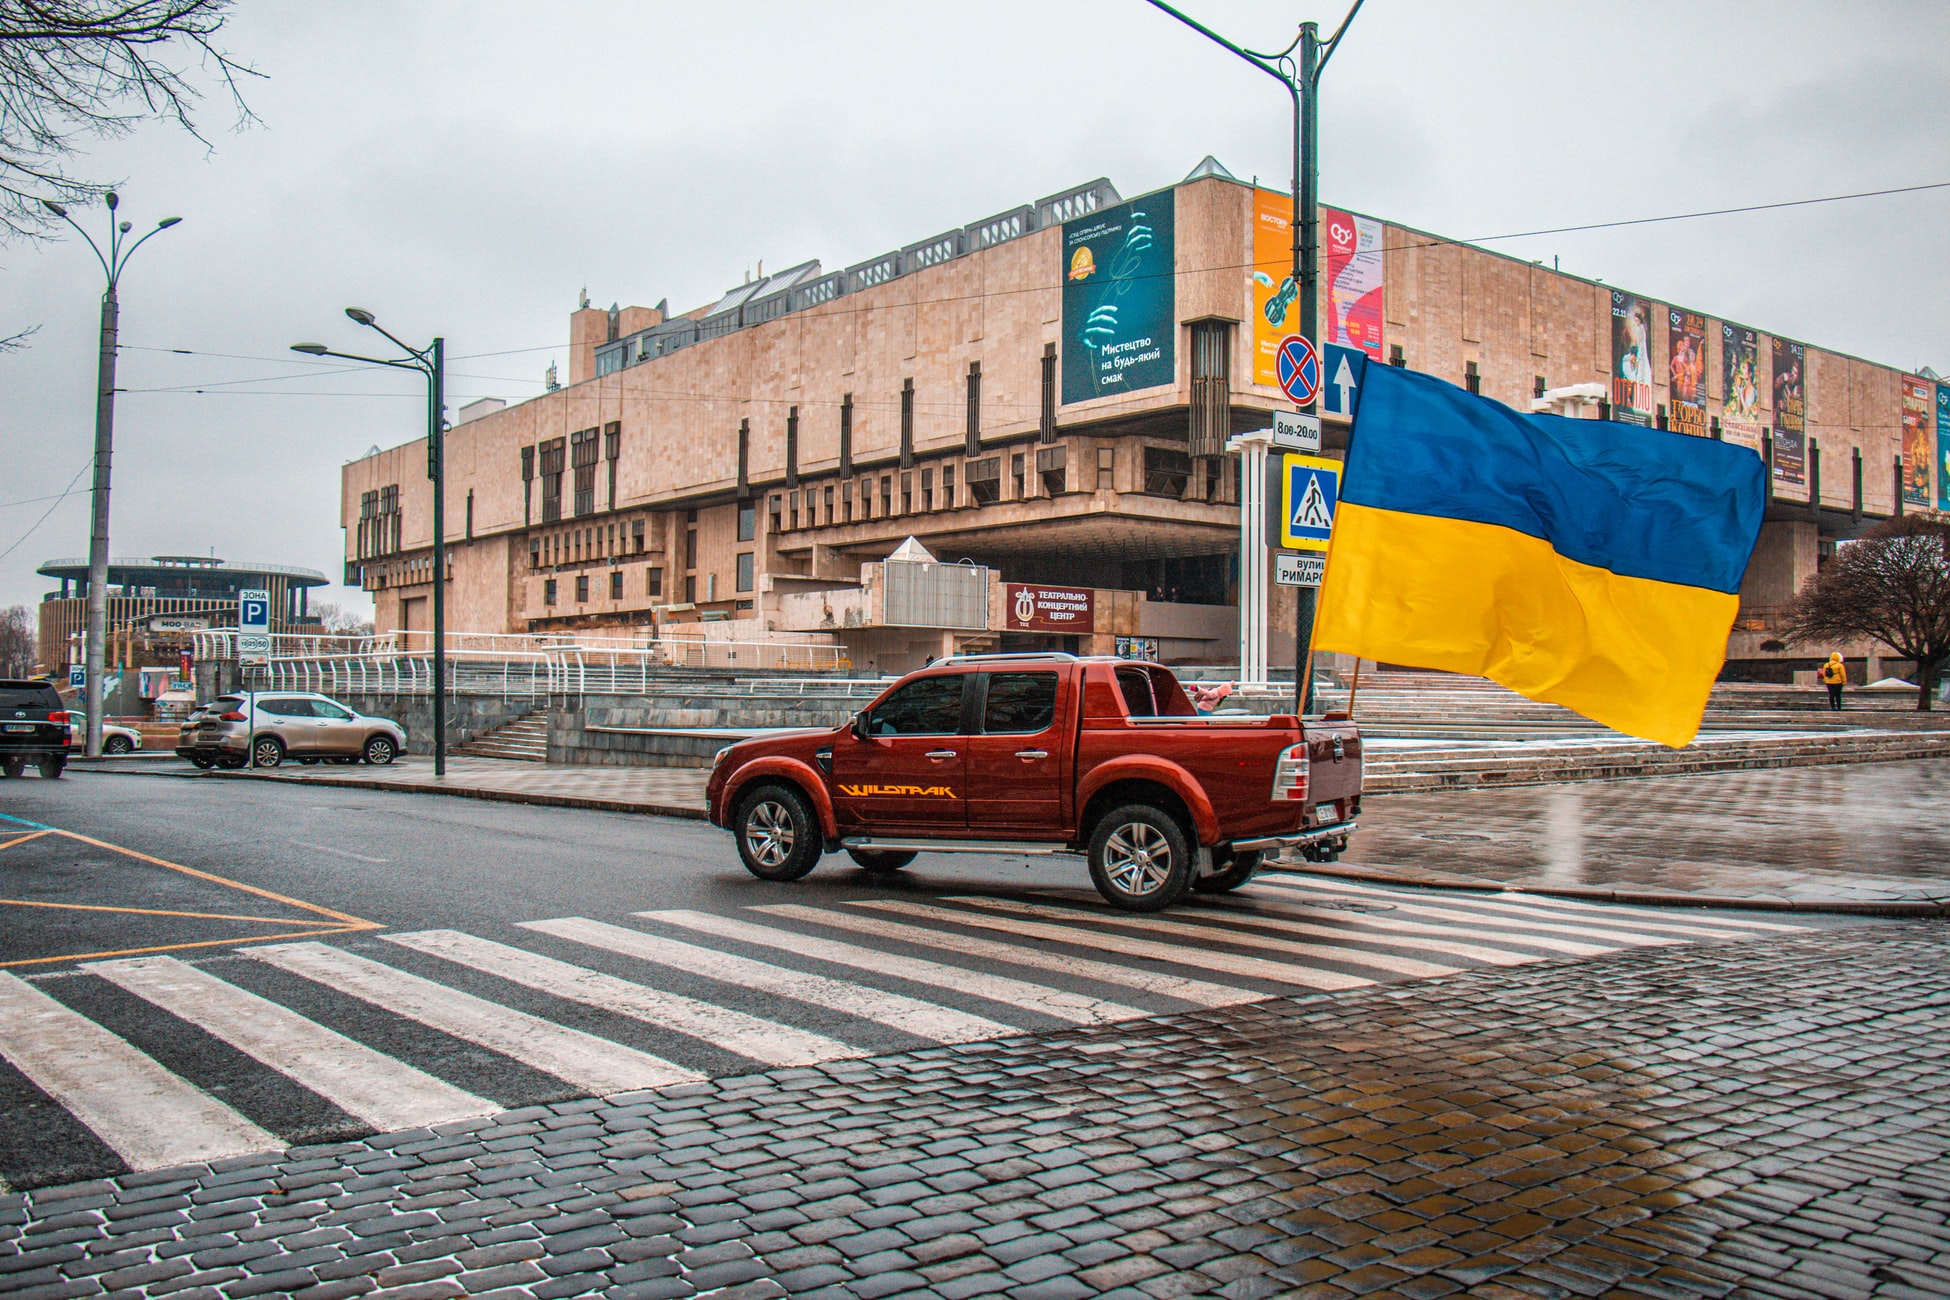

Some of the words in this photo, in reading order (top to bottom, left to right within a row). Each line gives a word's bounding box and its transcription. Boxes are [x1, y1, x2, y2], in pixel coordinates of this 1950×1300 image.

[1101, 337, 1151, 356] Мистецтво
[1101, 360, 1112, 370] на
[1114, 347, 1160, 370] будь-який
[1101, 372, 1123, 385] смак
[243, 591, 267, 600] ЗОНА
[1038, 591, 1089, 601] ТЕАТРАЛЬНО-
[1037, 601, 1088, 611] КОНЦЕРТНИЙ
[1050, 612, 1075, 621] ЦЕНТР
[258, 640, 267, 648] 50
[838, 784, 958, 799] WILDTRAK
